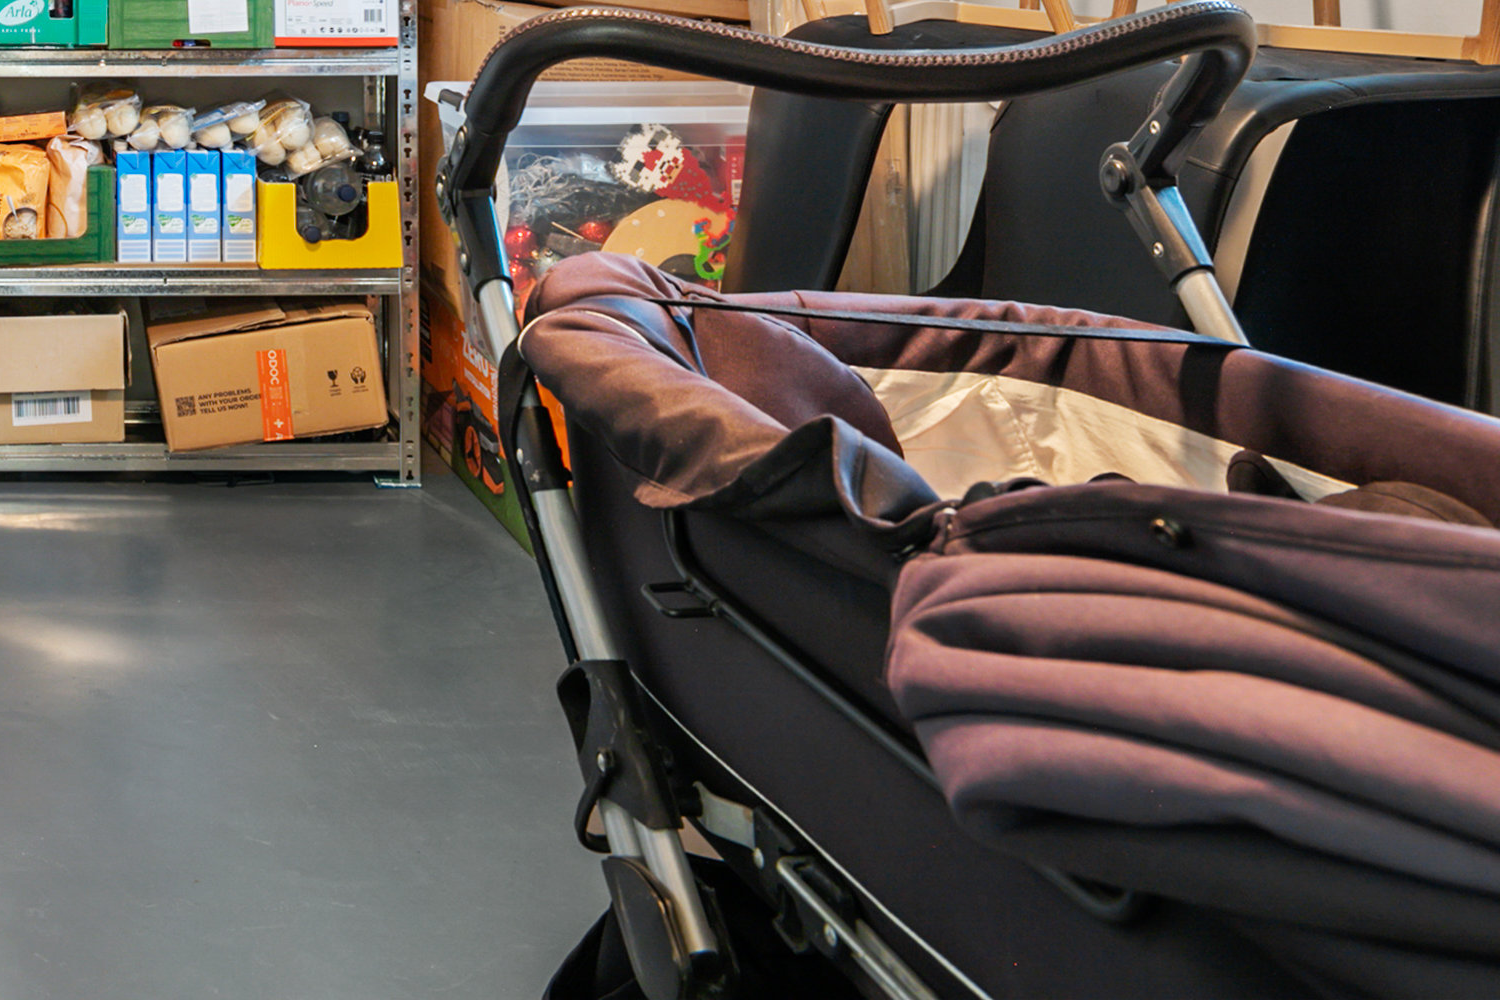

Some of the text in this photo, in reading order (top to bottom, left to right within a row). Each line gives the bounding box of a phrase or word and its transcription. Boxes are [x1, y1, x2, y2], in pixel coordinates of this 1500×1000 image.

[5, 4, 32, 18] Arla
[198, 388, 252, 401] ANY PROBLEMS
[199, 399, 218, 408] WITH
[219, 397, 238, 405] YOUR
[200, 406, 217, 415] TELL
[217, 404, 228, 412] US
